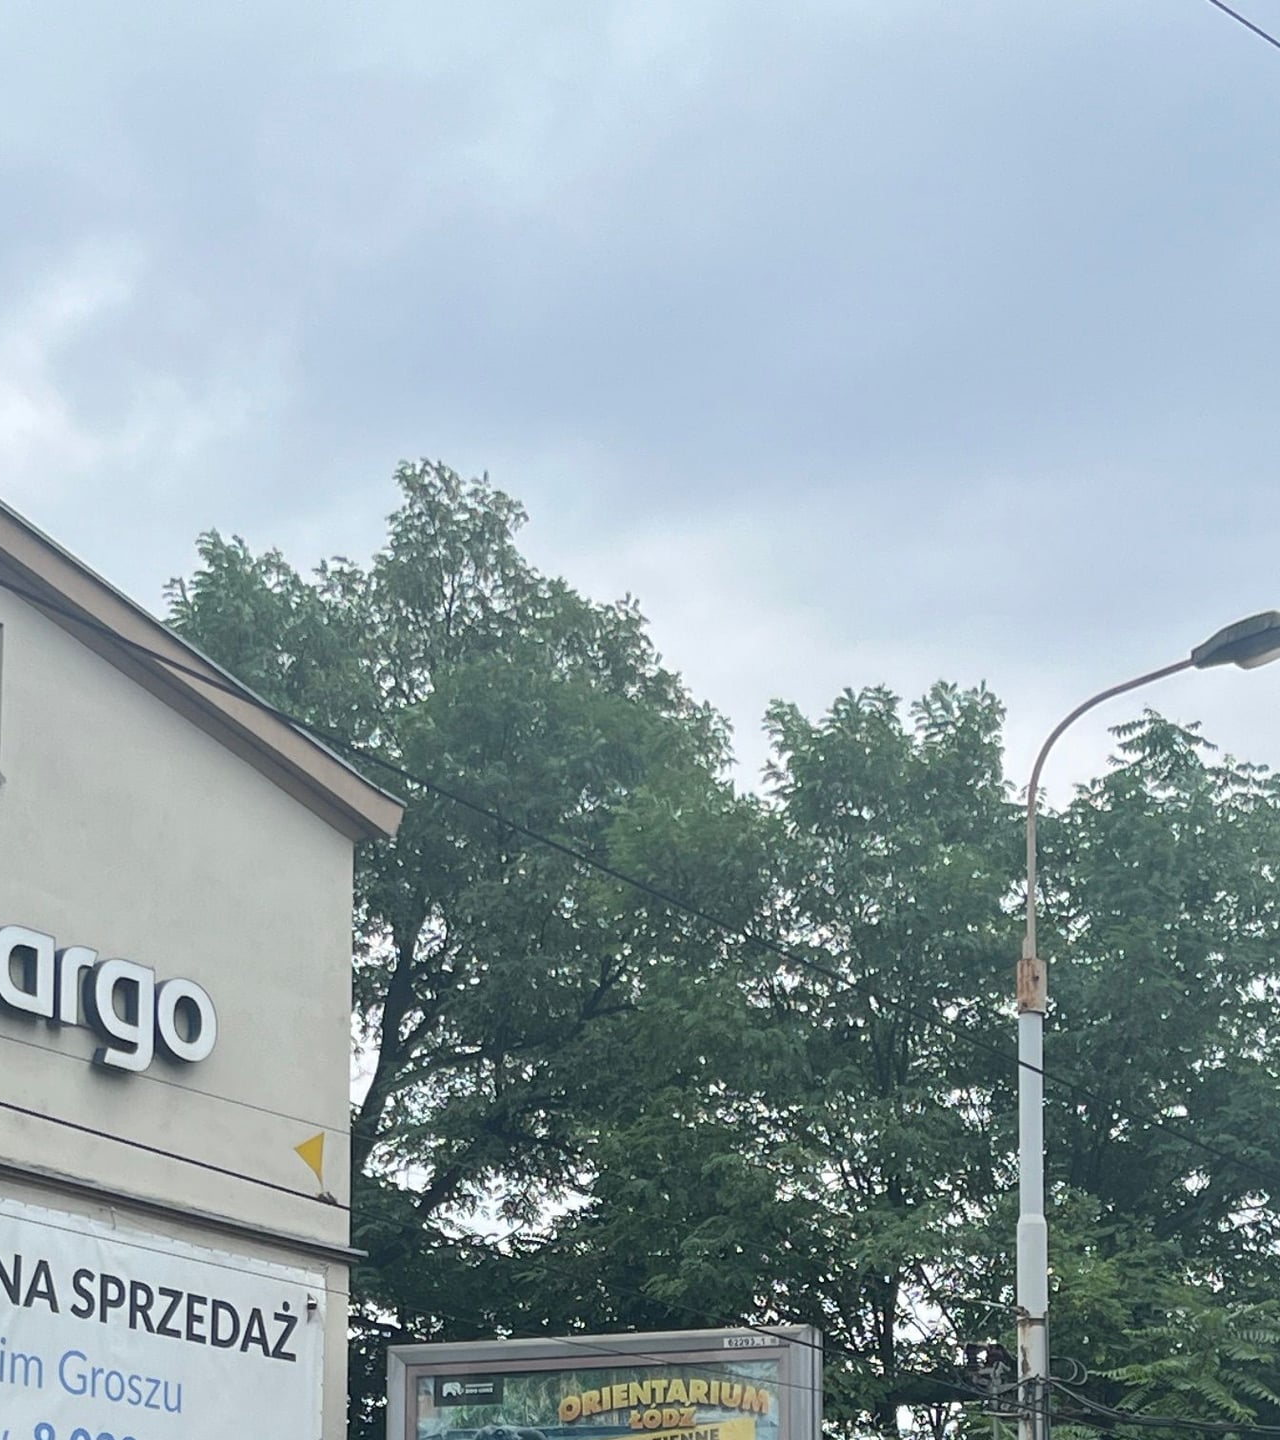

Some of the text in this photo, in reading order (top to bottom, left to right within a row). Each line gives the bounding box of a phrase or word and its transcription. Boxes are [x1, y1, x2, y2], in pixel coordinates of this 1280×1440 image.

[71, 1268, 298, 1362] SPRZEDAŻ
[58, 1349, 183, 1413] Groszu
[558, 1378, 771, 1423] ORIENTARIUM
